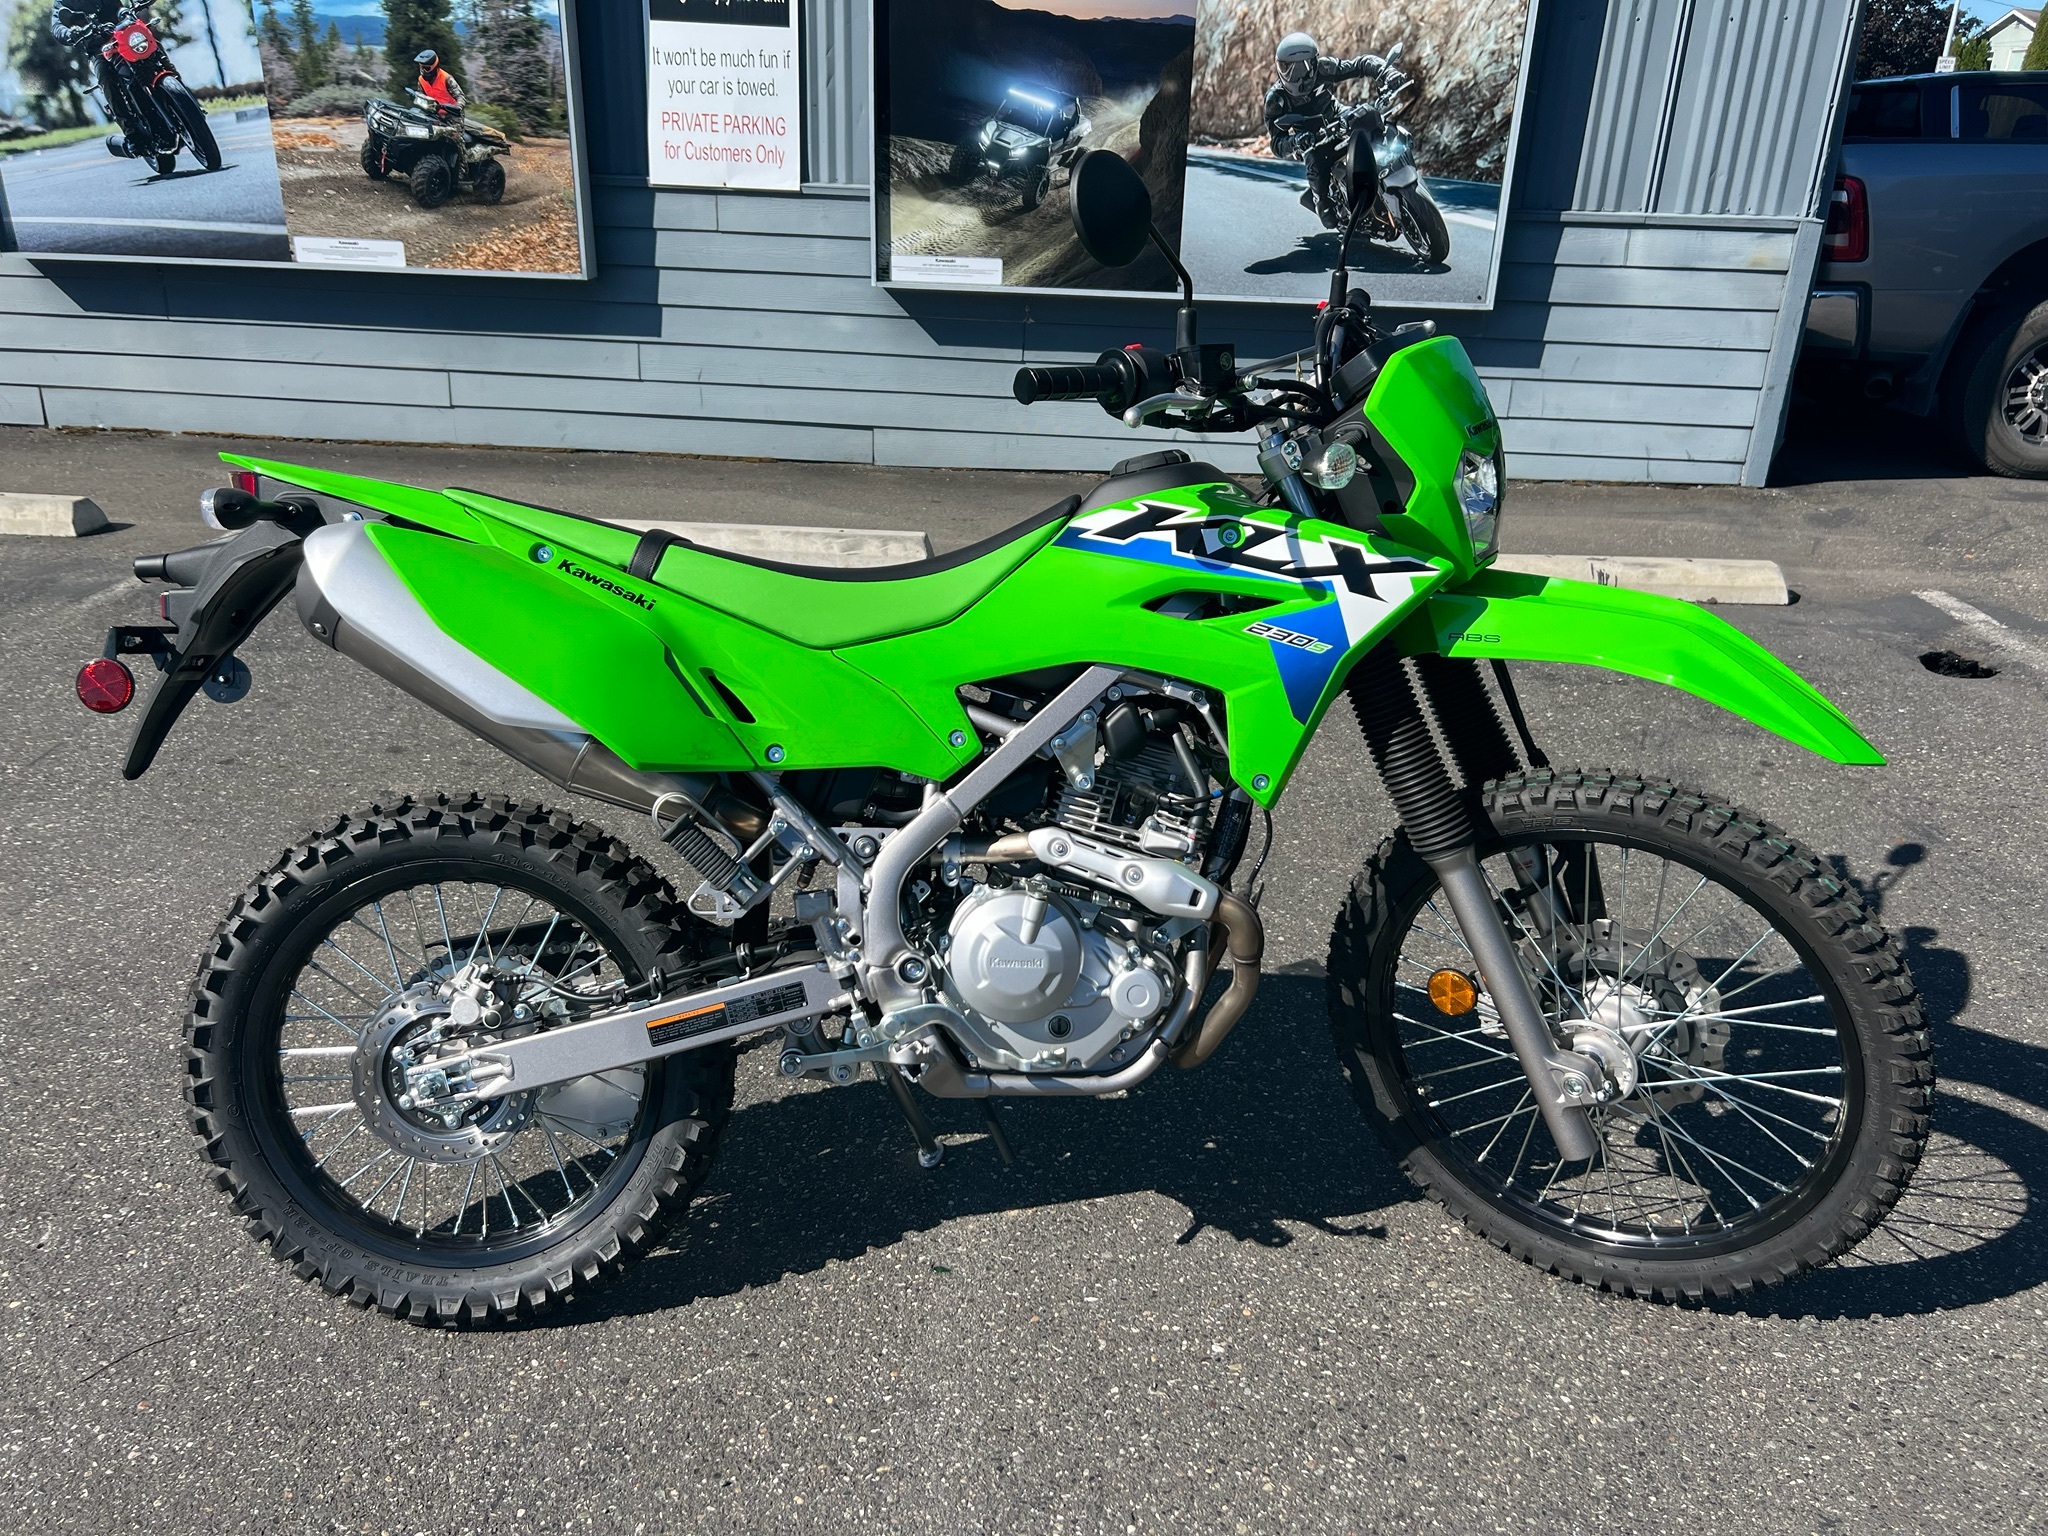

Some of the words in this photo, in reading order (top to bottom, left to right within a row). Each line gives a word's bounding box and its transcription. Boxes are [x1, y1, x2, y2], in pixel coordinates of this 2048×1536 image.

[653, 46, 661, 66] It
[664, 47, 697, 66] won't
[701, 48, 716, 67] be
[720, 49, 755, 68] much
[759, 49, 778, 69] fun
[783, 50, 791, 69] if
[668, 79, 695, 98] your
[700, 80, 719, 95] car
[723, 76, 733, 95] is
[737, 78, 779, 97] towed.
[662, 111, 720, 133] PRIVATE
[724, 114, 786, 136] PARKING
[664, 140, 681, 159] for
[685, 141, 752, 163] Customers
[756, 144, 785, 169] Only
[1091, 500, 1440, 603] KLX
[557, 559, 656, 611] Kawasaki
[1448, 632, 1501, 643] ABS
[989, 957, 1044, 969] Kawasaki
[282, 1205, 354, 1261] GP-22R
[363, 1259, 449, 1288] TRAILS
